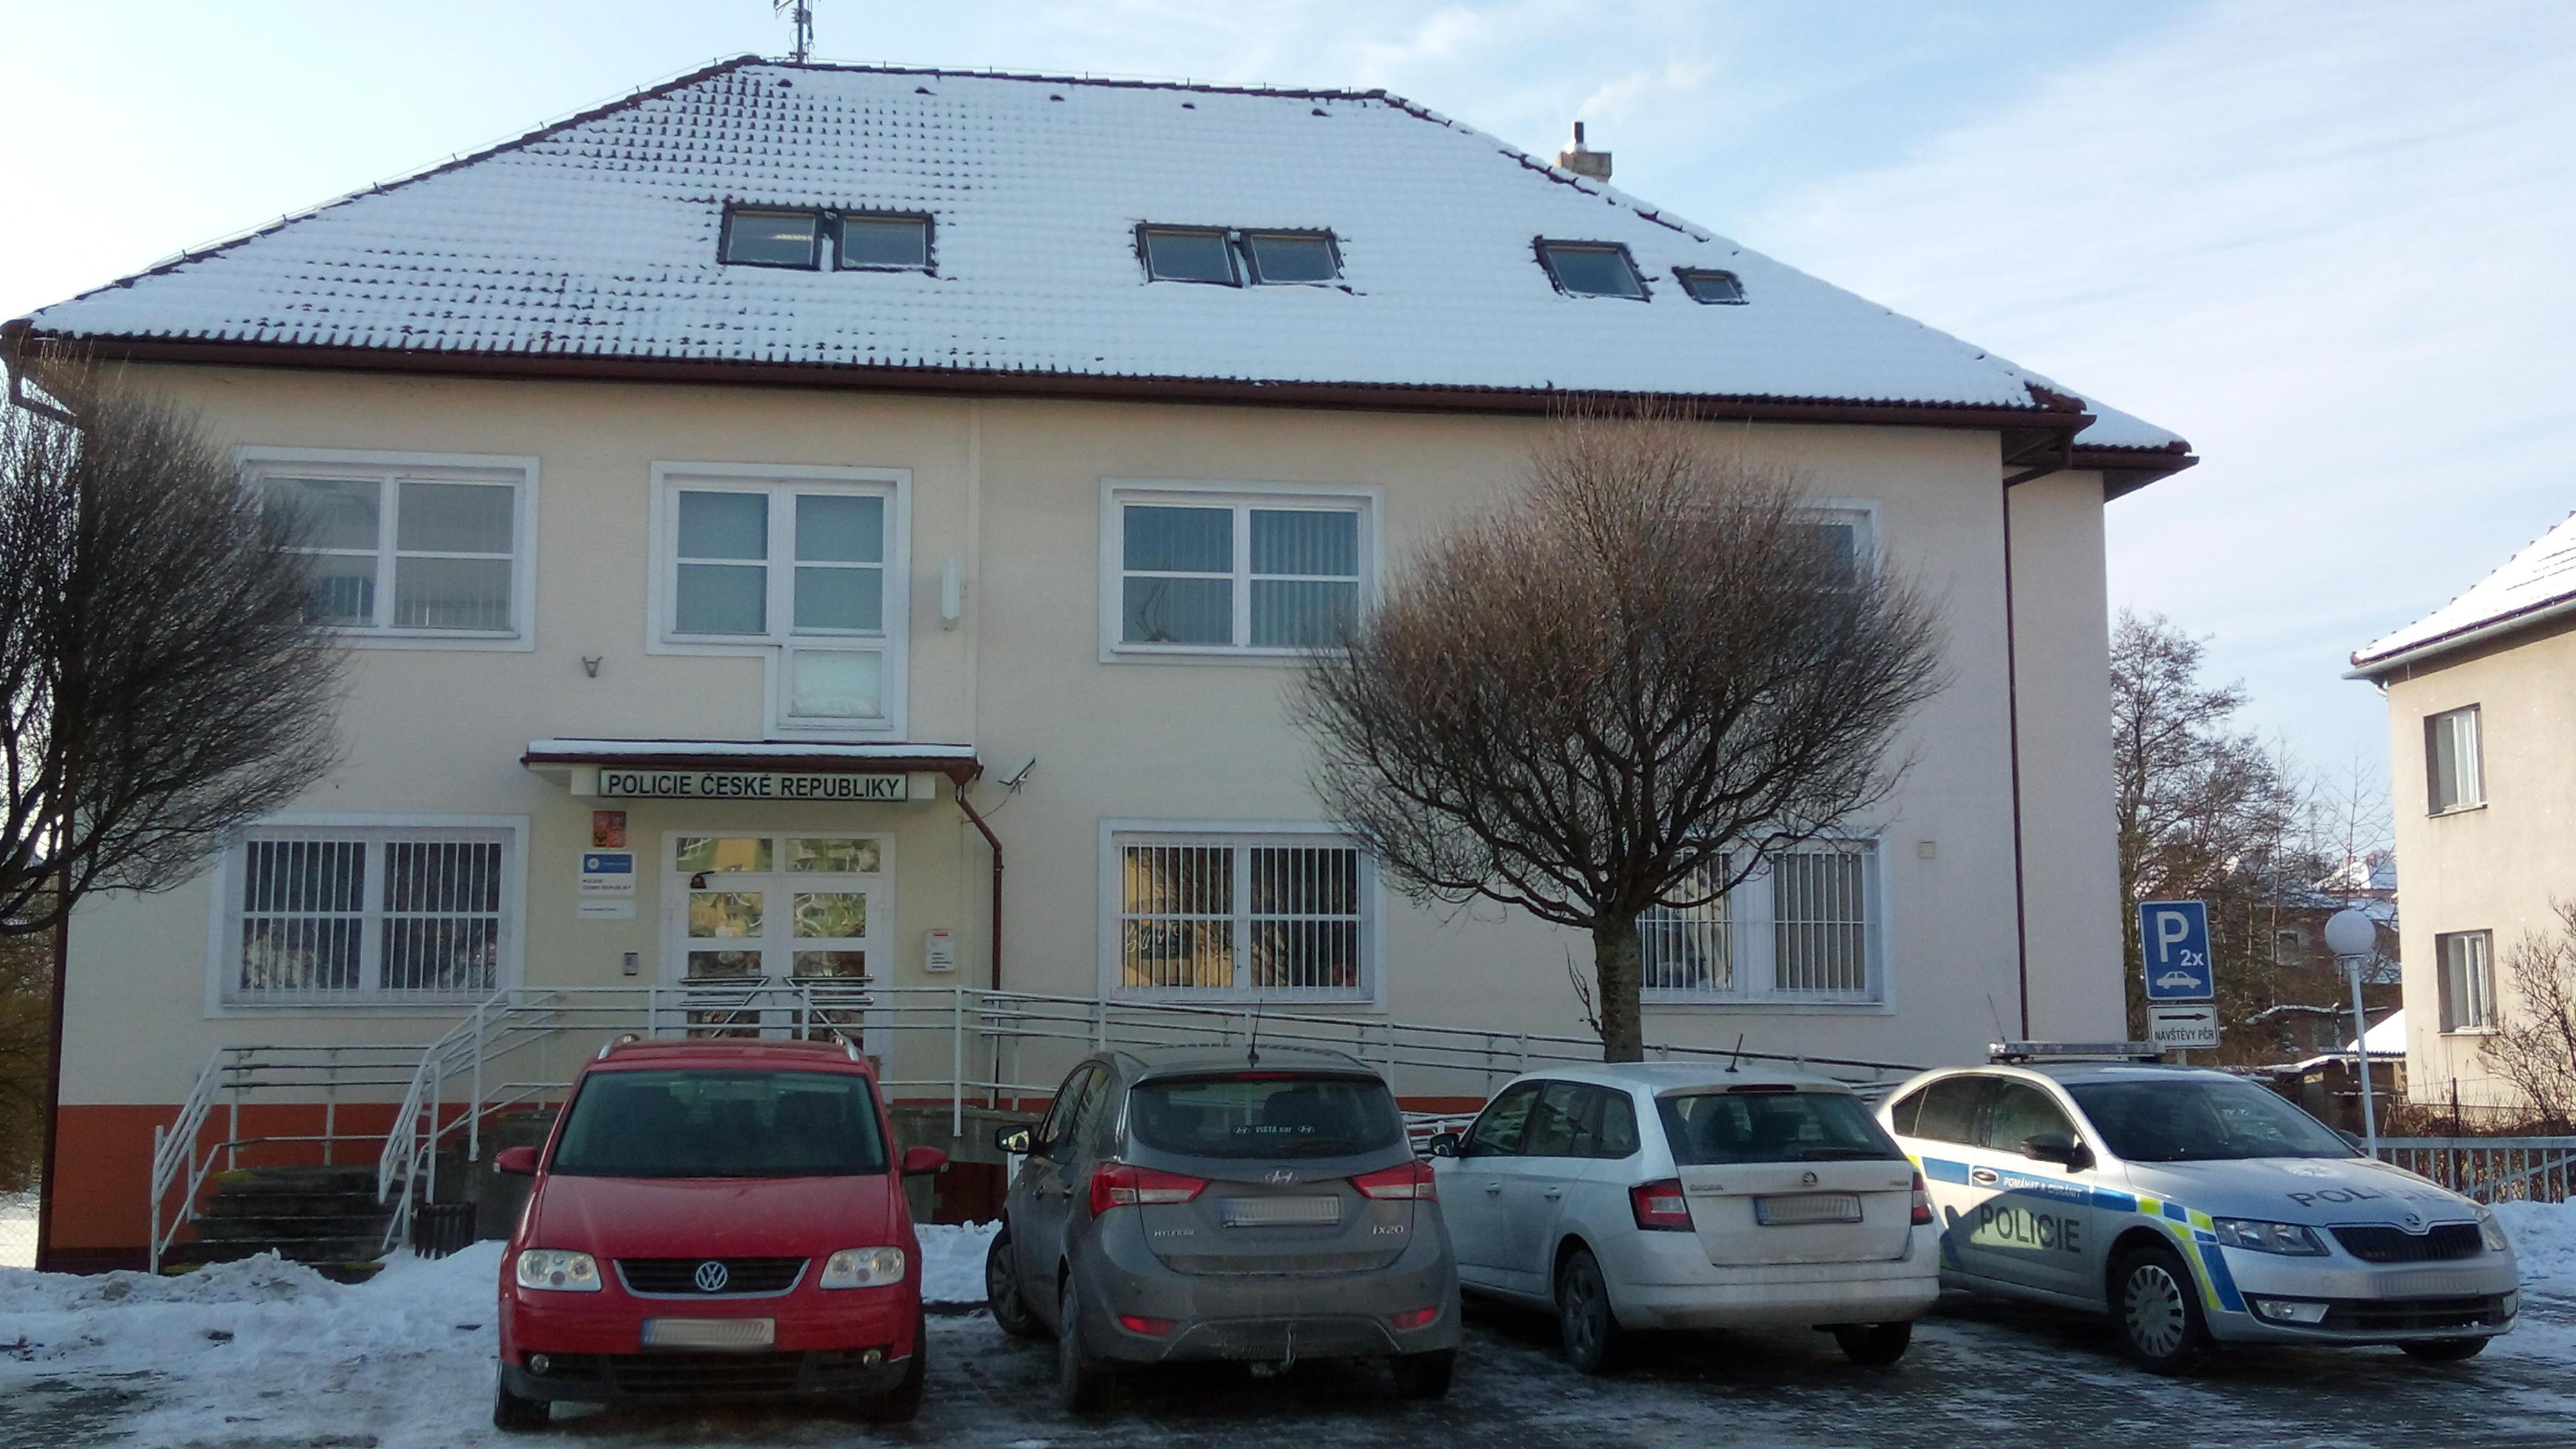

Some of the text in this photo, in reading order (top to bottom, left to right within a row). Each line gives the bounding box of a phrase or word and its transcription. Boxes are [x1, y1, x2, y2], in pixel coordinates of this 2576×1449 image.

[608, 773, 900, 797] POLICIE ČESKÉ REPUBLIKY
[2156, 911, 2189, 963] P
[2179, 949, 2204, 966] 2x
[2198, 1027, 2214, 1040] PČR
[1980, 1202, 2081, 1253] POLICIE
